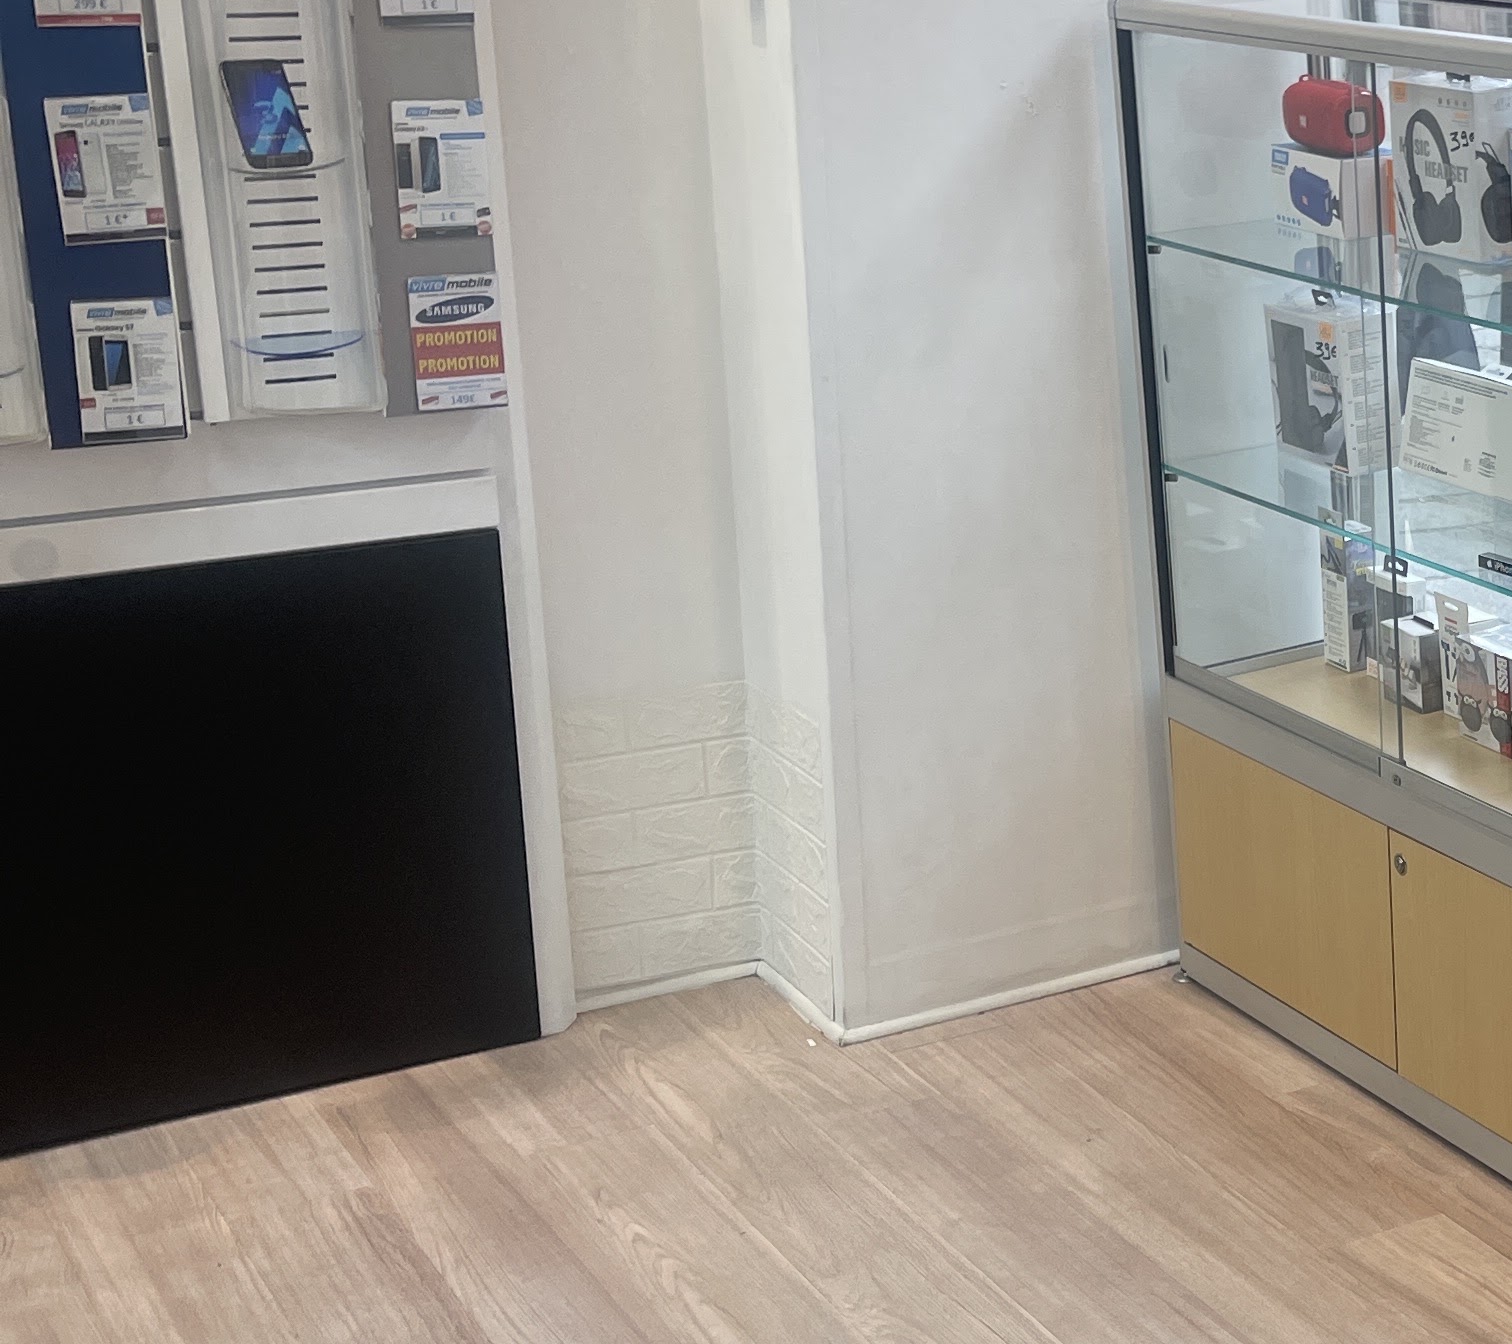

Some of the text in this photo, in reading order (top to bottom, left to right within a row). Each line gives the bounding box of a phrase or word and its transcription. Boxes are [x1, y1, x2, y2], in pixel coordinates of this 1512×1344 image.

[410, 277, 493, 293] vivre mobile
[425, 302, 485, 317] SAMSUNG
[415, 328, 497, 349] PROMOTION
[418, 354, 500, 375] PROMOTION
